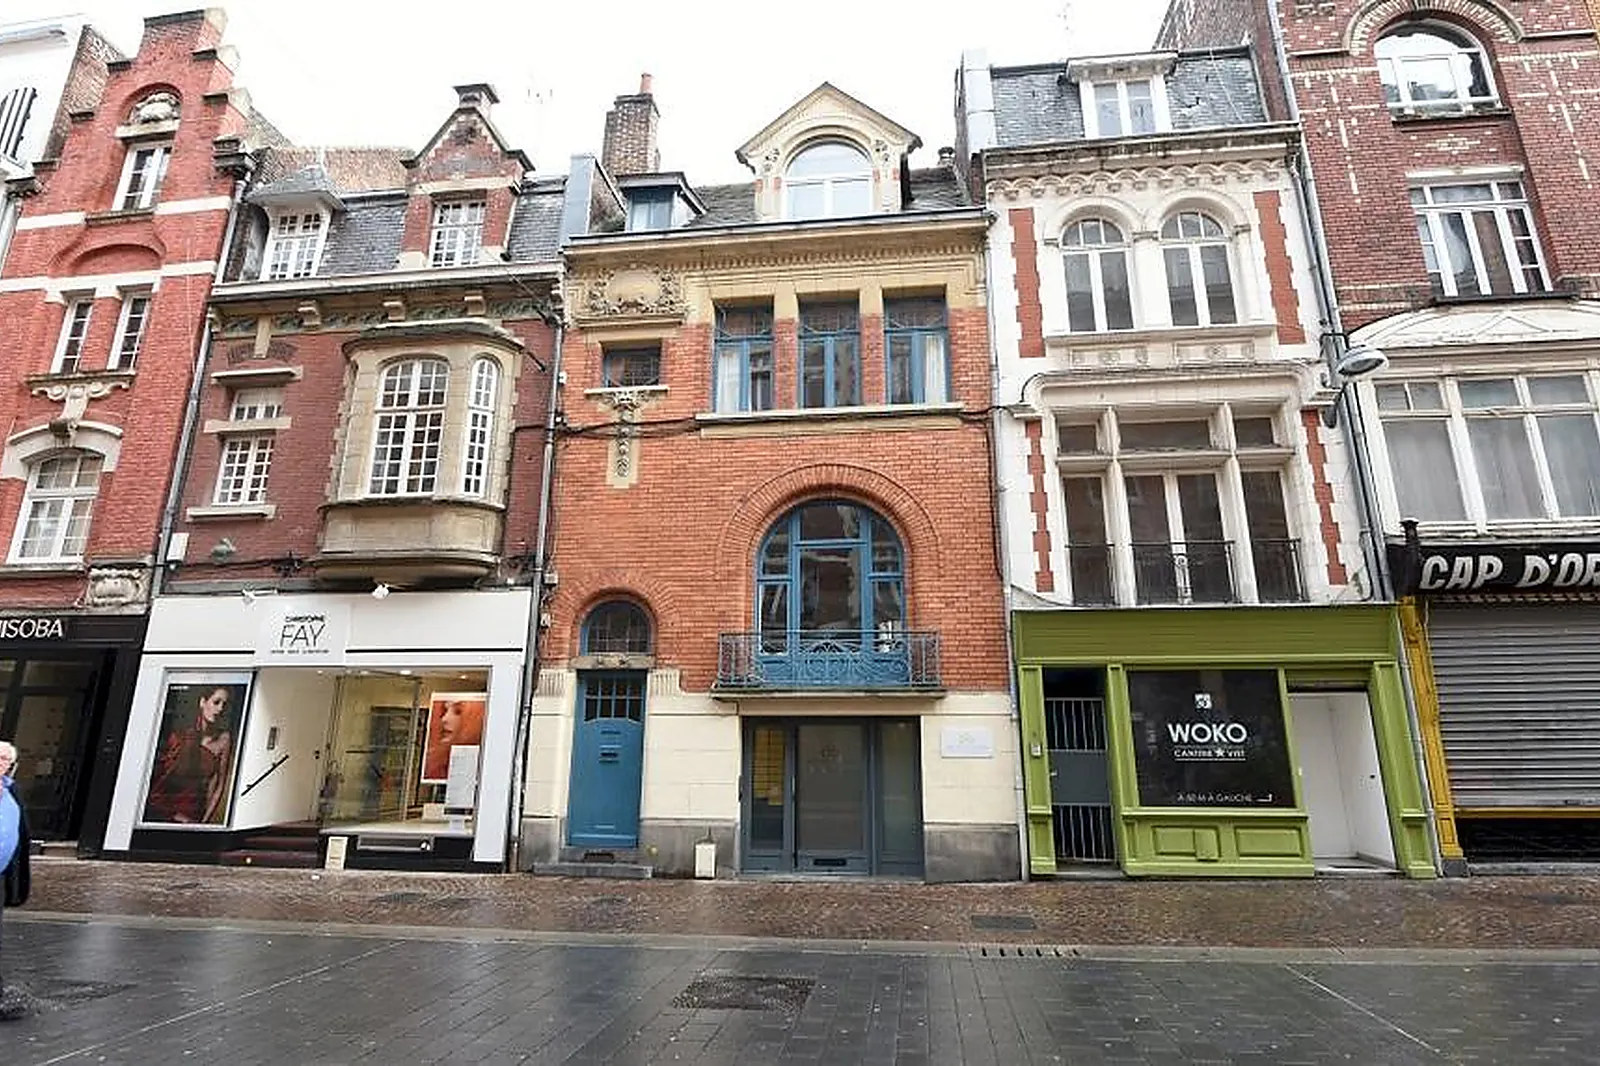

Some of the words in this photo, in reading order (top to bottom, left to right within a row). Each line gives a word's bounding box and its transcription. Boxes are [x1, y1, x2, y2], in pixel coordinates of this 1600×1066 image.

[1419, 555, 1503, 590] CAP
[1516, 553, 1600, 588] D'OR
[0, 619, 63, 638] ISOBA
[280, 624, 325, 647] FAY
[1167, 723, 1247, 743] WOKO
